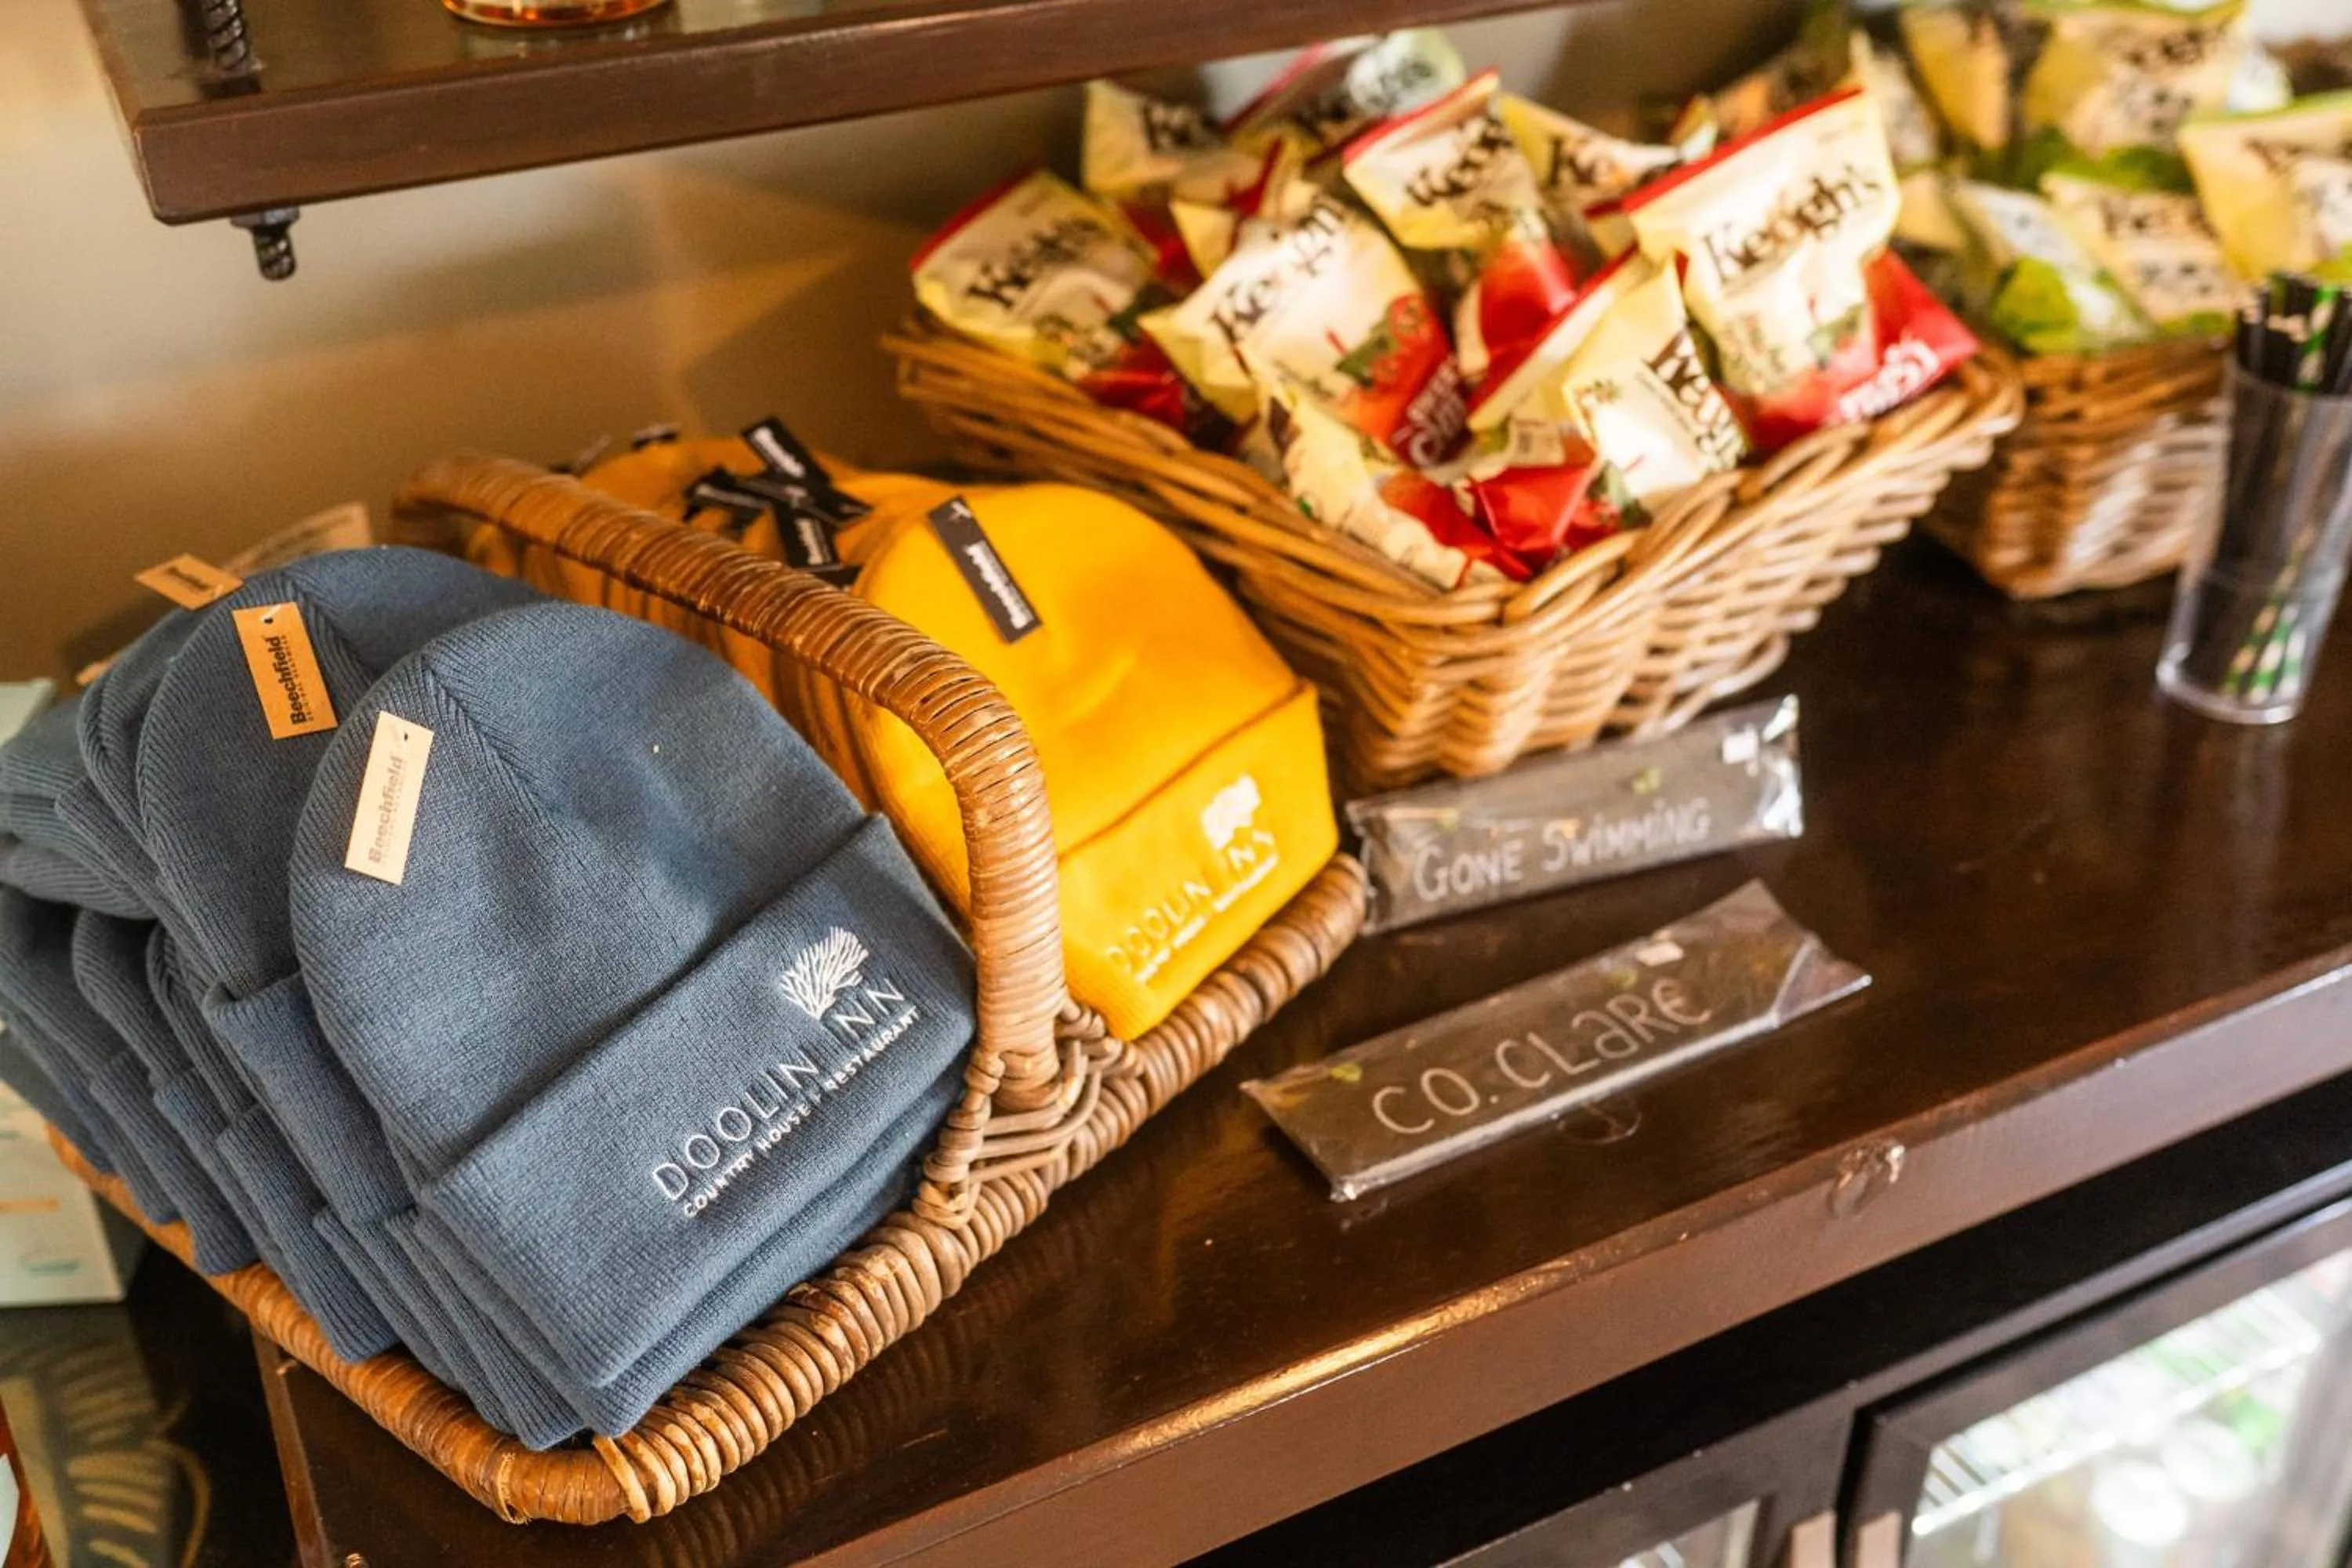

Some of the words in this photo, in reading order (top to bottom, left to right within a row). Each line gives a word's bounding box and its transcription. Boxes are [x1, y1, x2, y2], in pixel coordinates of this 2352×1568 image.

[264, 636, 307, 725] Beechfield
[368, 754, 403, 862] Beechfield
[1414, 838, 1523, 902] GONE
[652, 1045, 819, 1200] DOOLIN
[684, 1149, 754, 1217] COUNTRY
[757, 1103, 811, 1152] HOUSE
[824, 1006, 920, 1091] RESTAURANT
